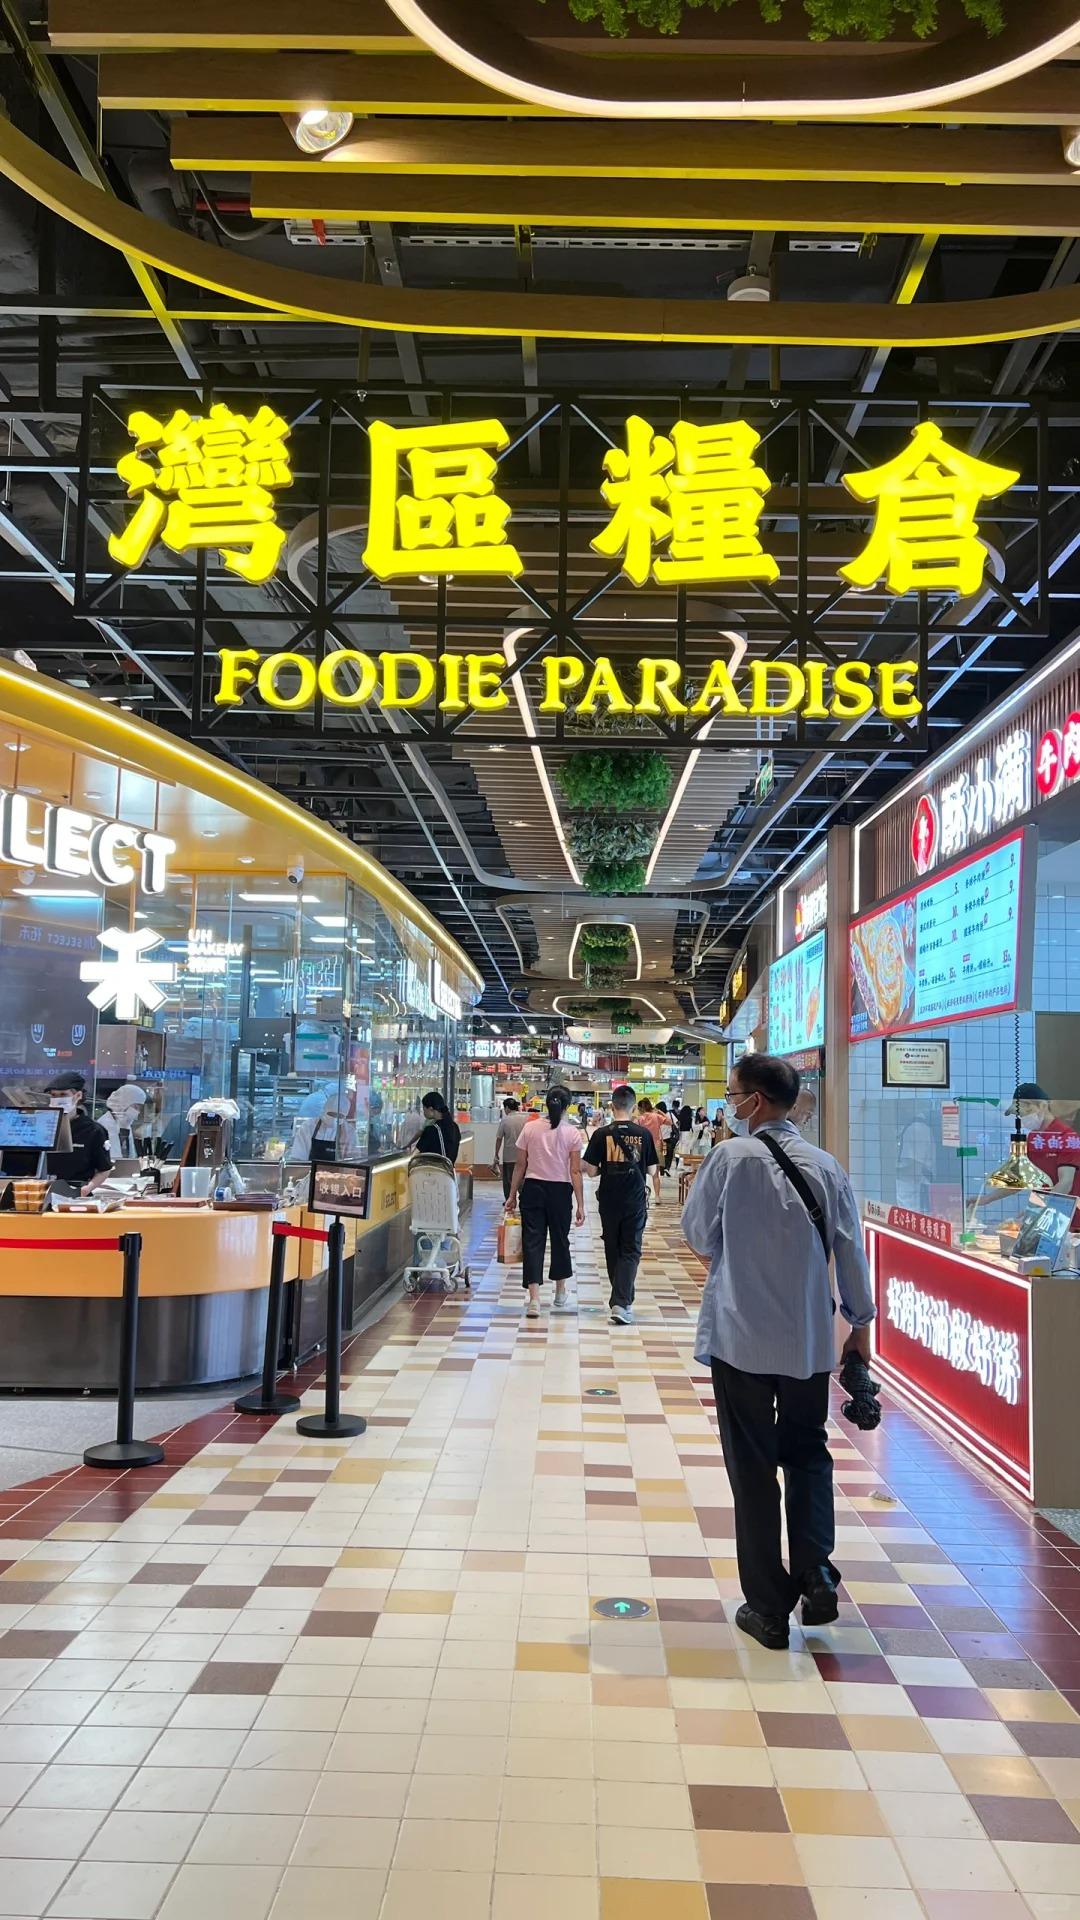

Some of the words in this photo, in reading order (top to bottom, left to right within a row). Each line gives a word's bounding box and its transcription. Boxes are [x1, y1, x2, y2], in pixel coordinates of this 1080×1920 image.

[107, 402, 1021, 596] 灣區糧倉
[214, 648, 509, 713] FOODIE
[539, 655, 922, 719] PARADISE
[188, 929, 213, 943] UH
[188, 943, 243, 957] BAKERY
[319, 1182, 362, 1199] 收银入口
